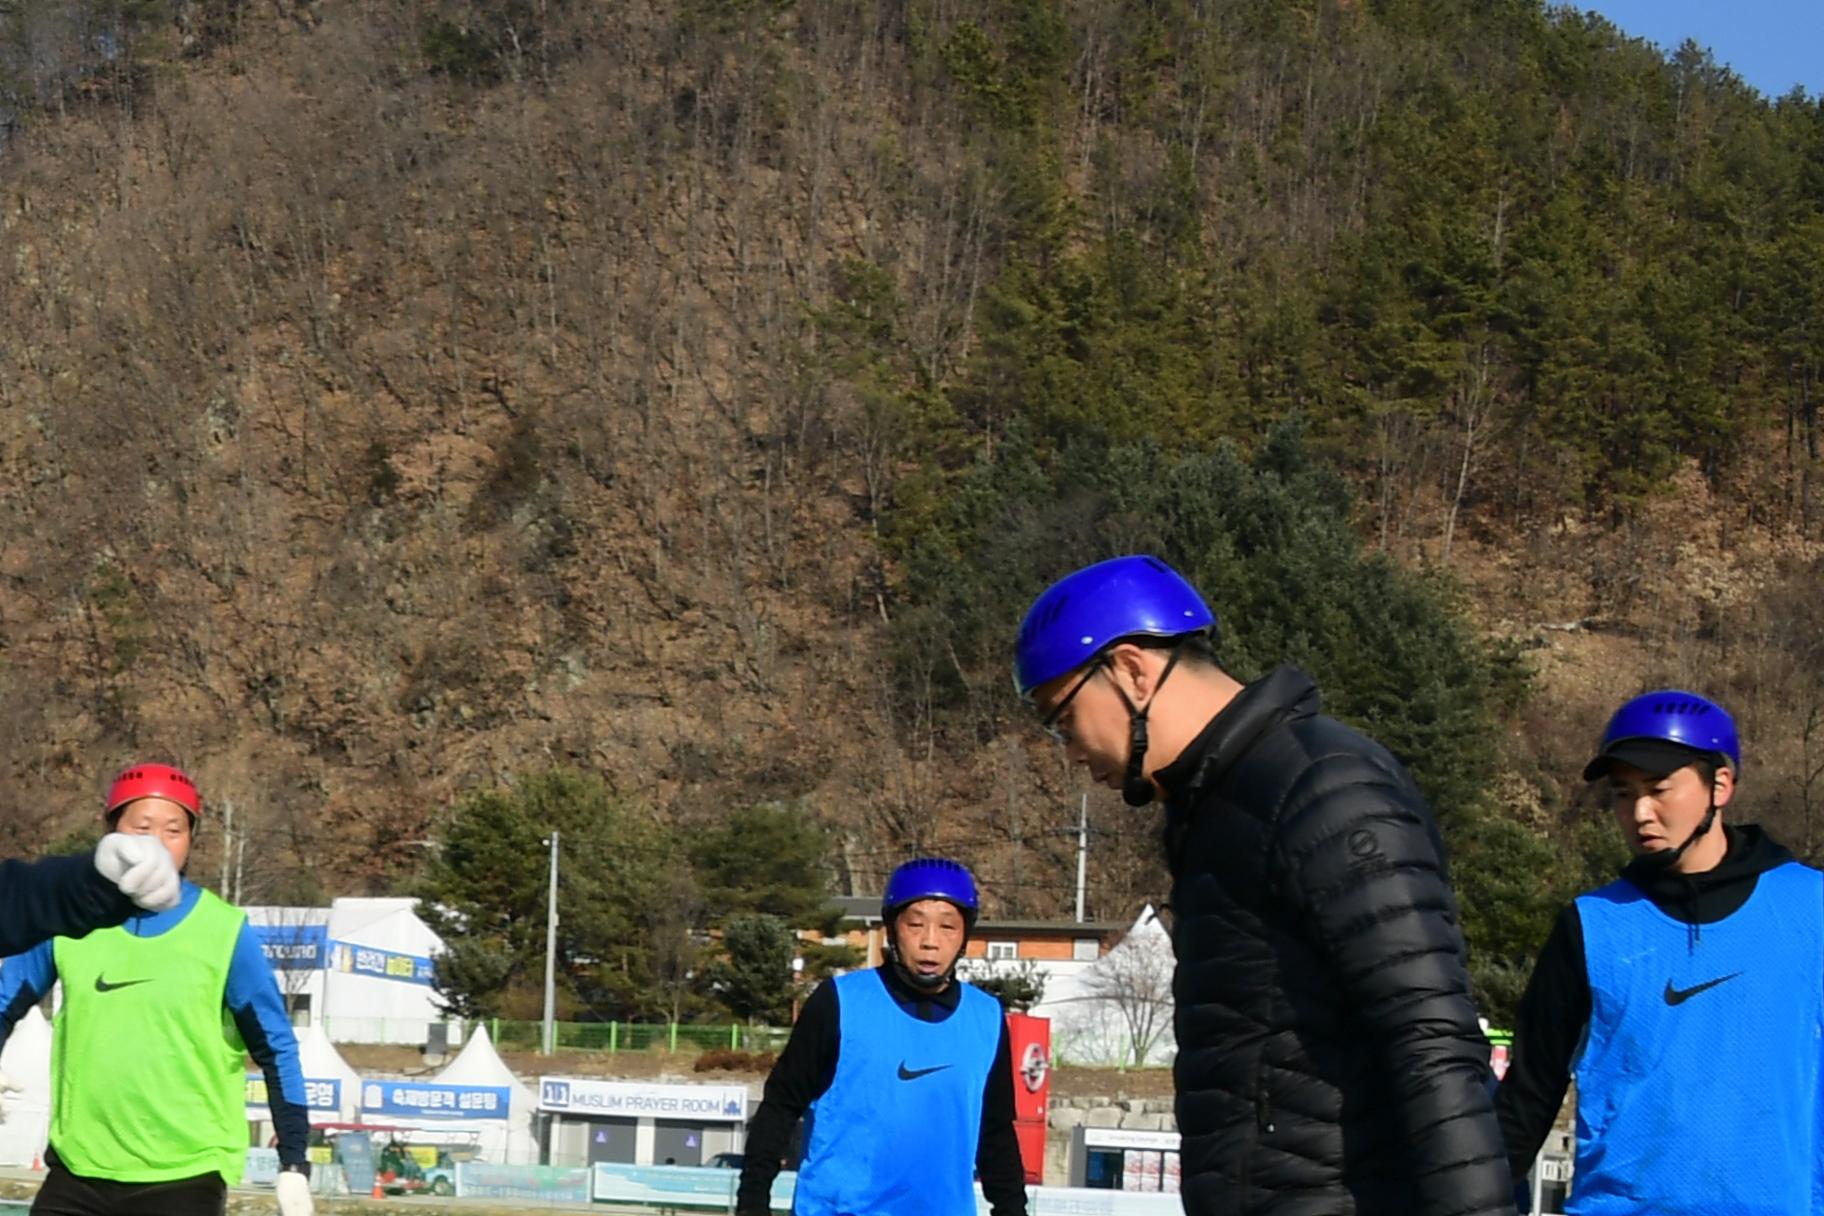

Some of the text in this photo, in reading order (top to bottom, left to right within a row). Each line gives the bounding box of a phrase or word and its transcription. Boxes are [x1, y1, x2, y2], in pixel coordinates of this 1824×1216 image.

[571, 1093, 720, 1114] MUSLIM PRAYER ROOM
